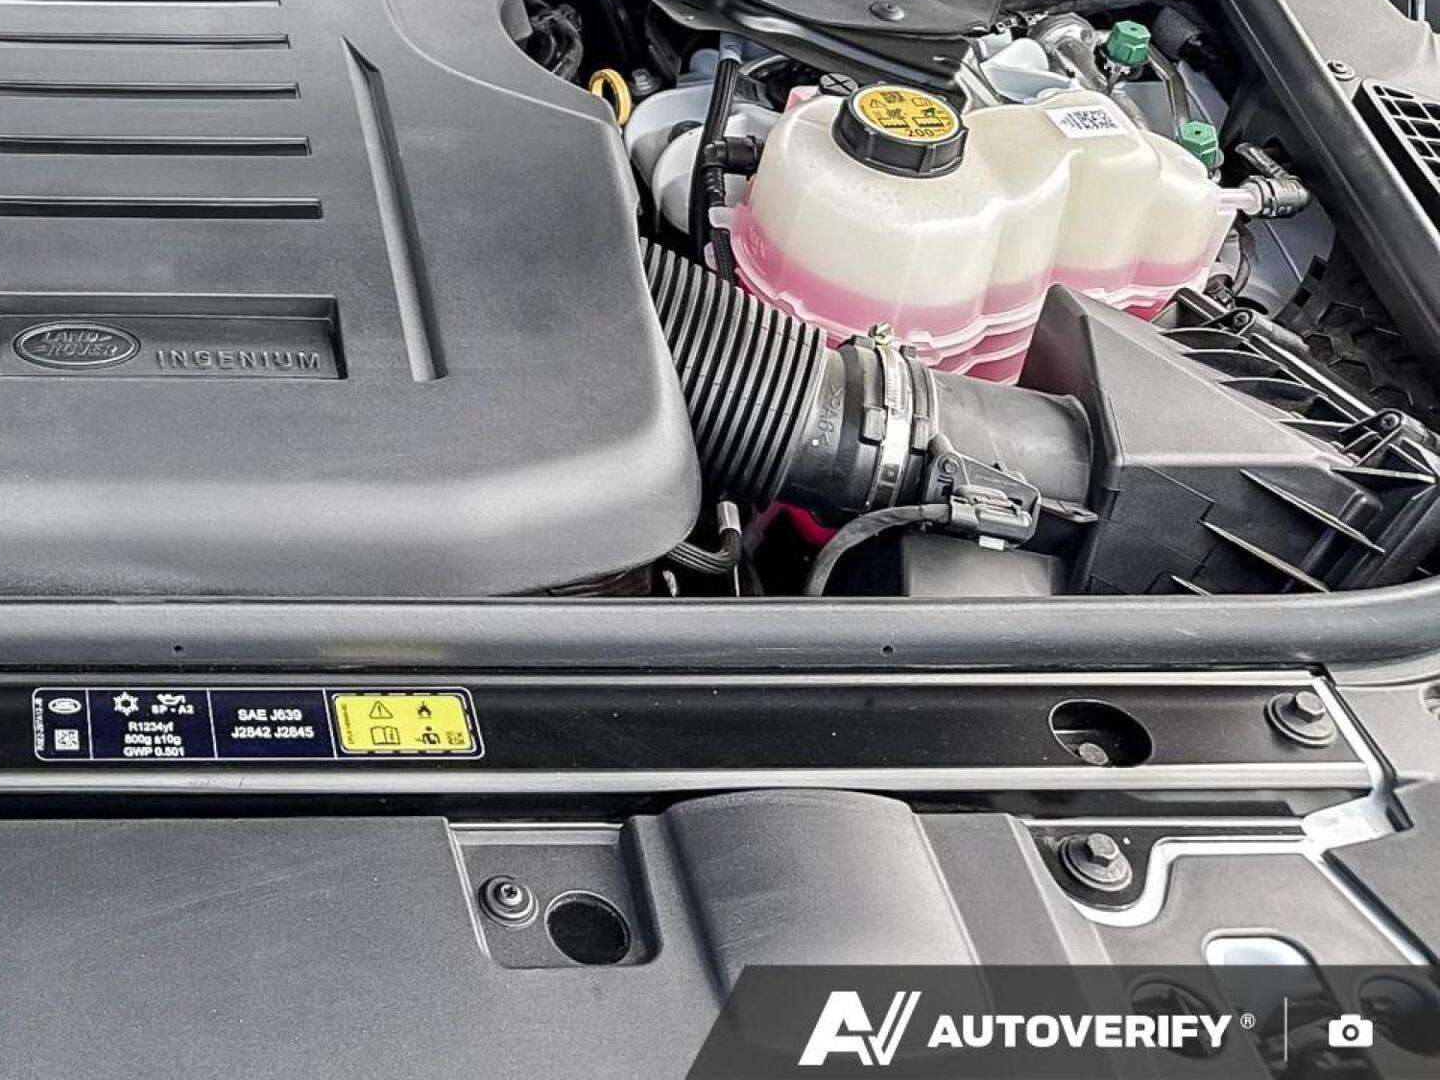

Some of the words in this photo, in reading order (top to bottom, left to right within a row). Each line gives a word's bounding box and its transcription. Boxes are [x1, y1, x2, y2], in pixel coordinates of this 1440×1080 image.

[47, 342, 119, 357] ROVER
[157, 349, 321, 370] INGENIUM
[237, 708, 268, 720] SAE
[269, 708, 303, 720] J639
[128, 721, 174, 733] R1234yf
[230, 725, 272, 738] J2842
[273, 725, 315, 738] J2845
[123, 746, 153, 756] GWP
[154, 746, 185, 756] 0.501
